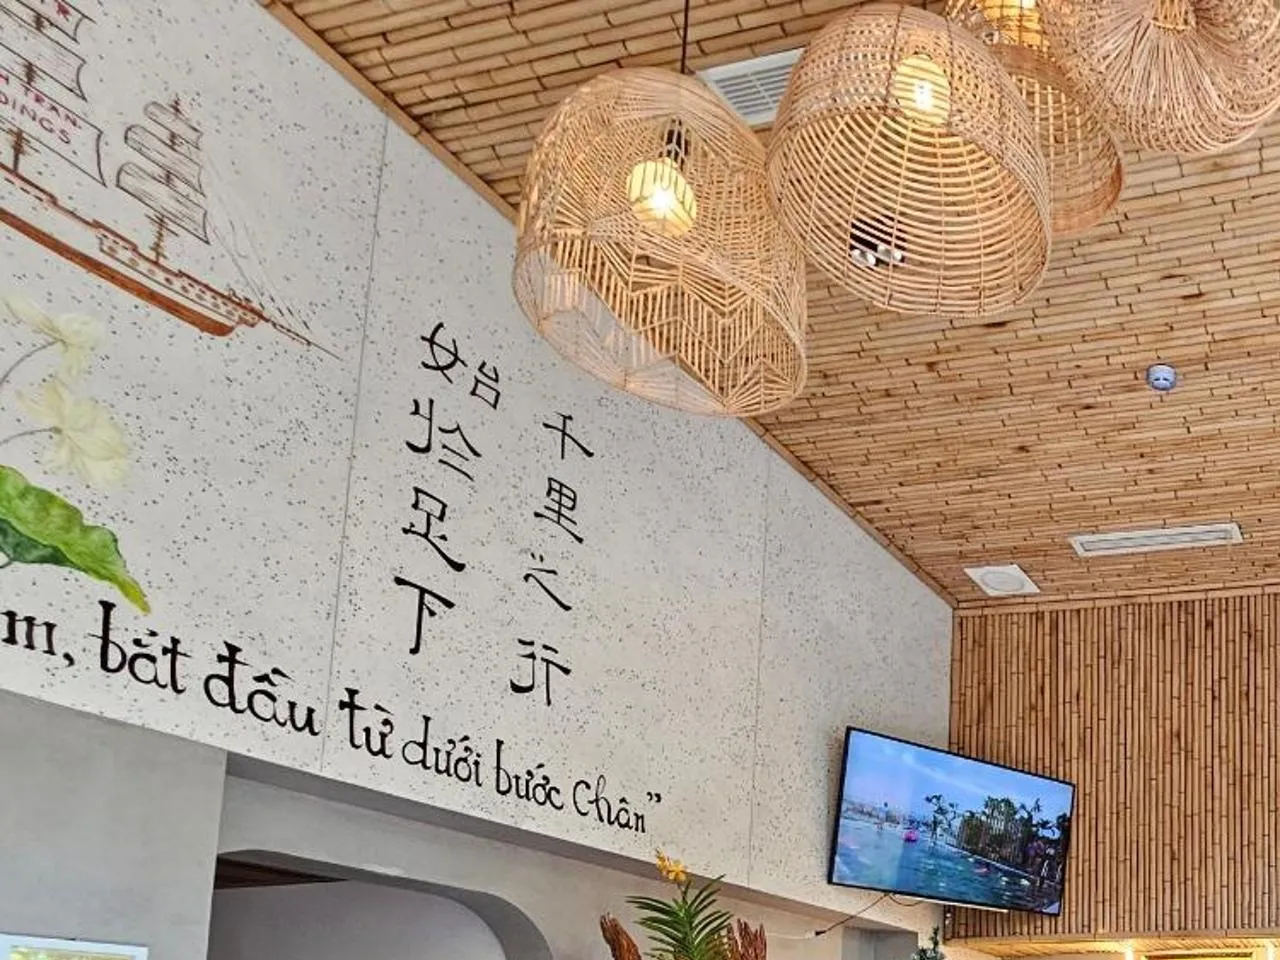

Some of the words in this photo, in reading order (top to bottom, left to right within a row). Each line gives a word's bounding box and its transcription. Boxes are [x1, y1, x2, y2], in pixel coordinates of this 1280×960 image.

[203, 640, 320, 736] đầu
[338, 687, 395, 759] từ
[402, 715, 482, 787] dưới
[495, 739, 564, 810] bước
